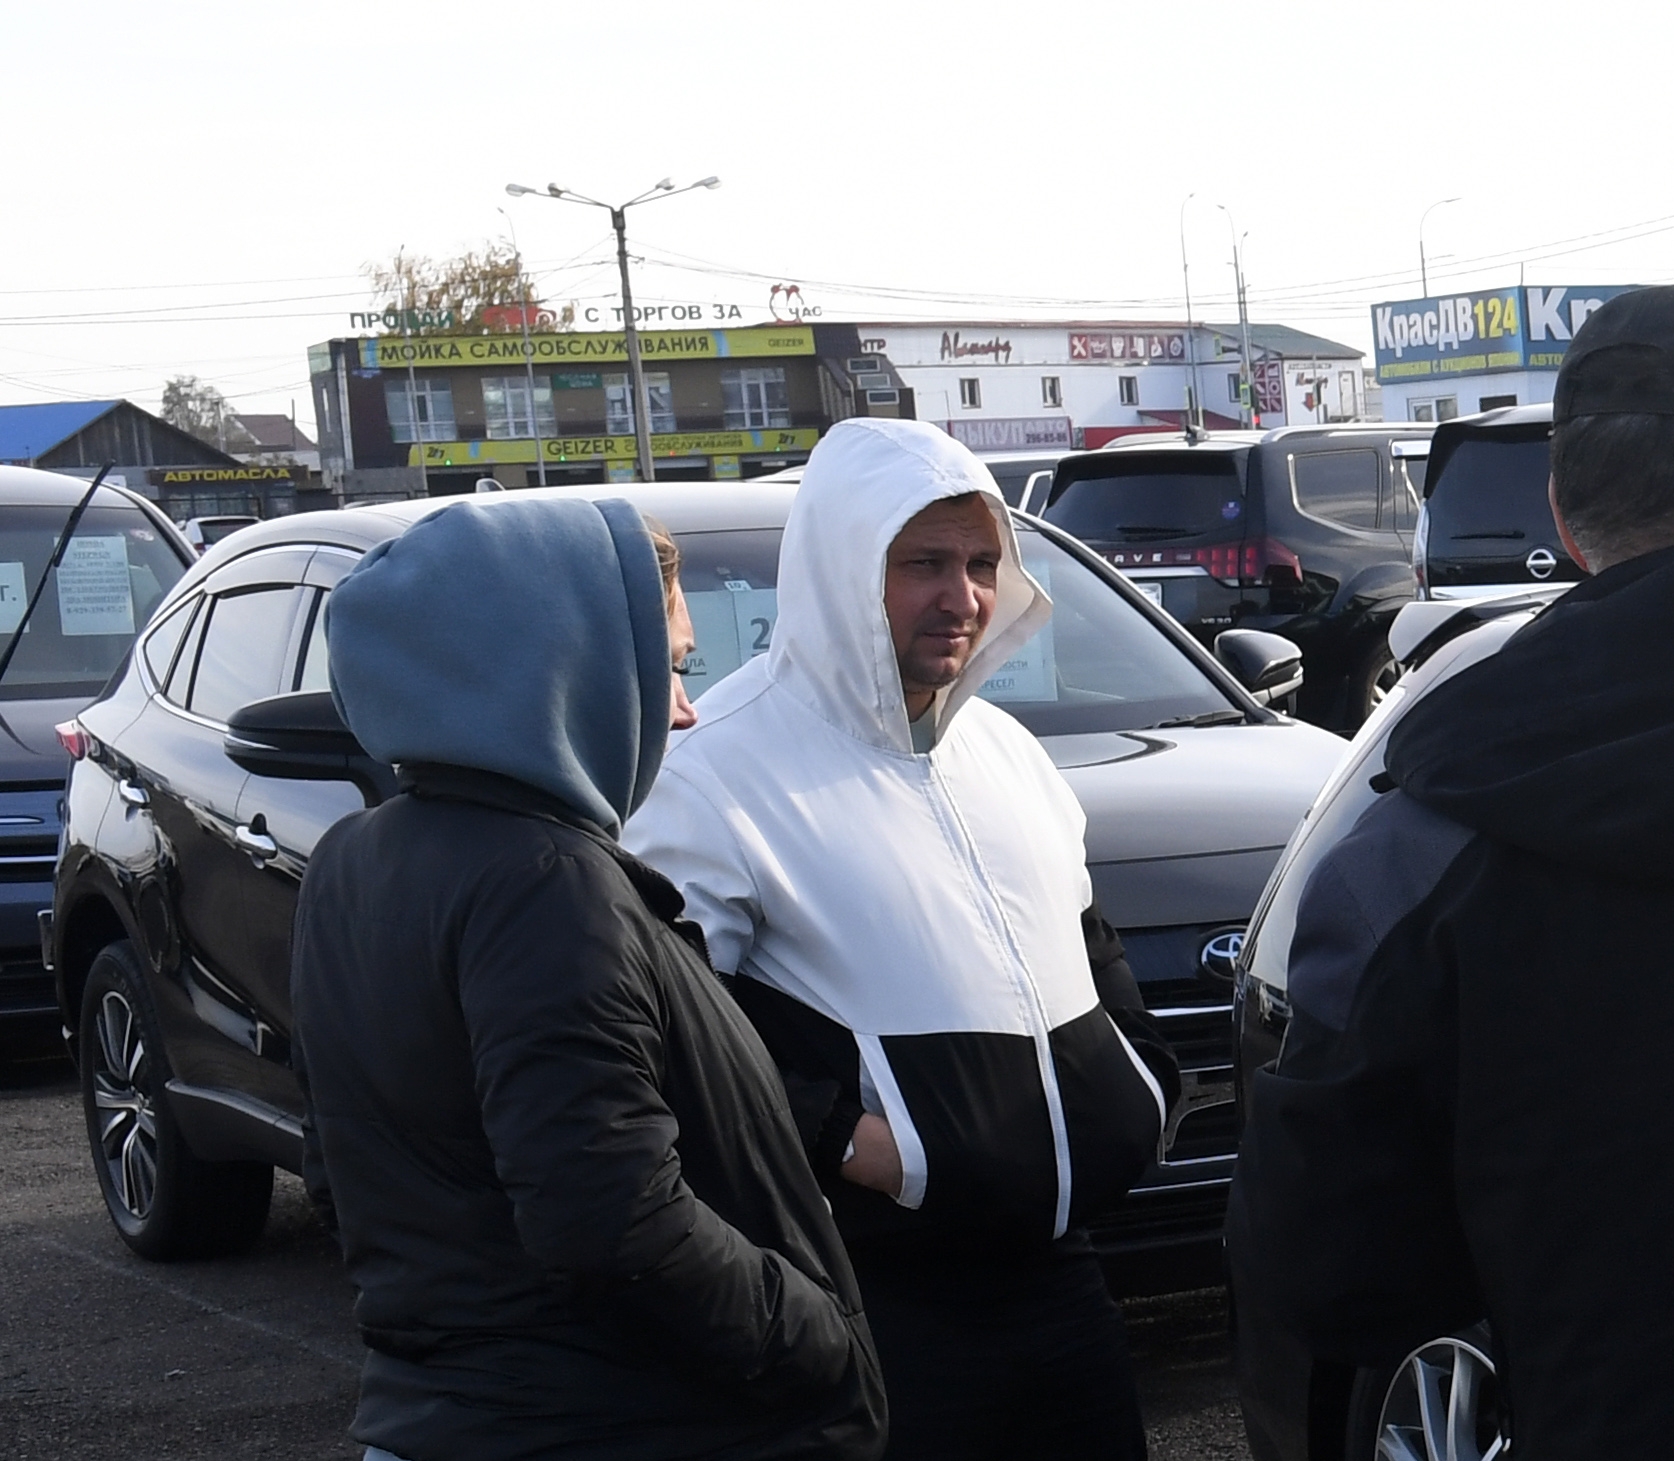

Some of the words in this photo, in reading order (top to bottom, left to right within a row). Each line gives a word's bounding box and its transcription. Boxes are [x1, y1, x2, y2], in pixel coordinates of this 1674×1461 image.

[1375, 296, 1519, 358] КрасДВ124
[381, 340, 462, 360] МОЙКА
[470, 336, 709, 358] САМООБСЛУЖВАНИЯ
[547, 439, 617, 455] GEIZER
[164, 468, 291, 482] АВТОМАСЛА
